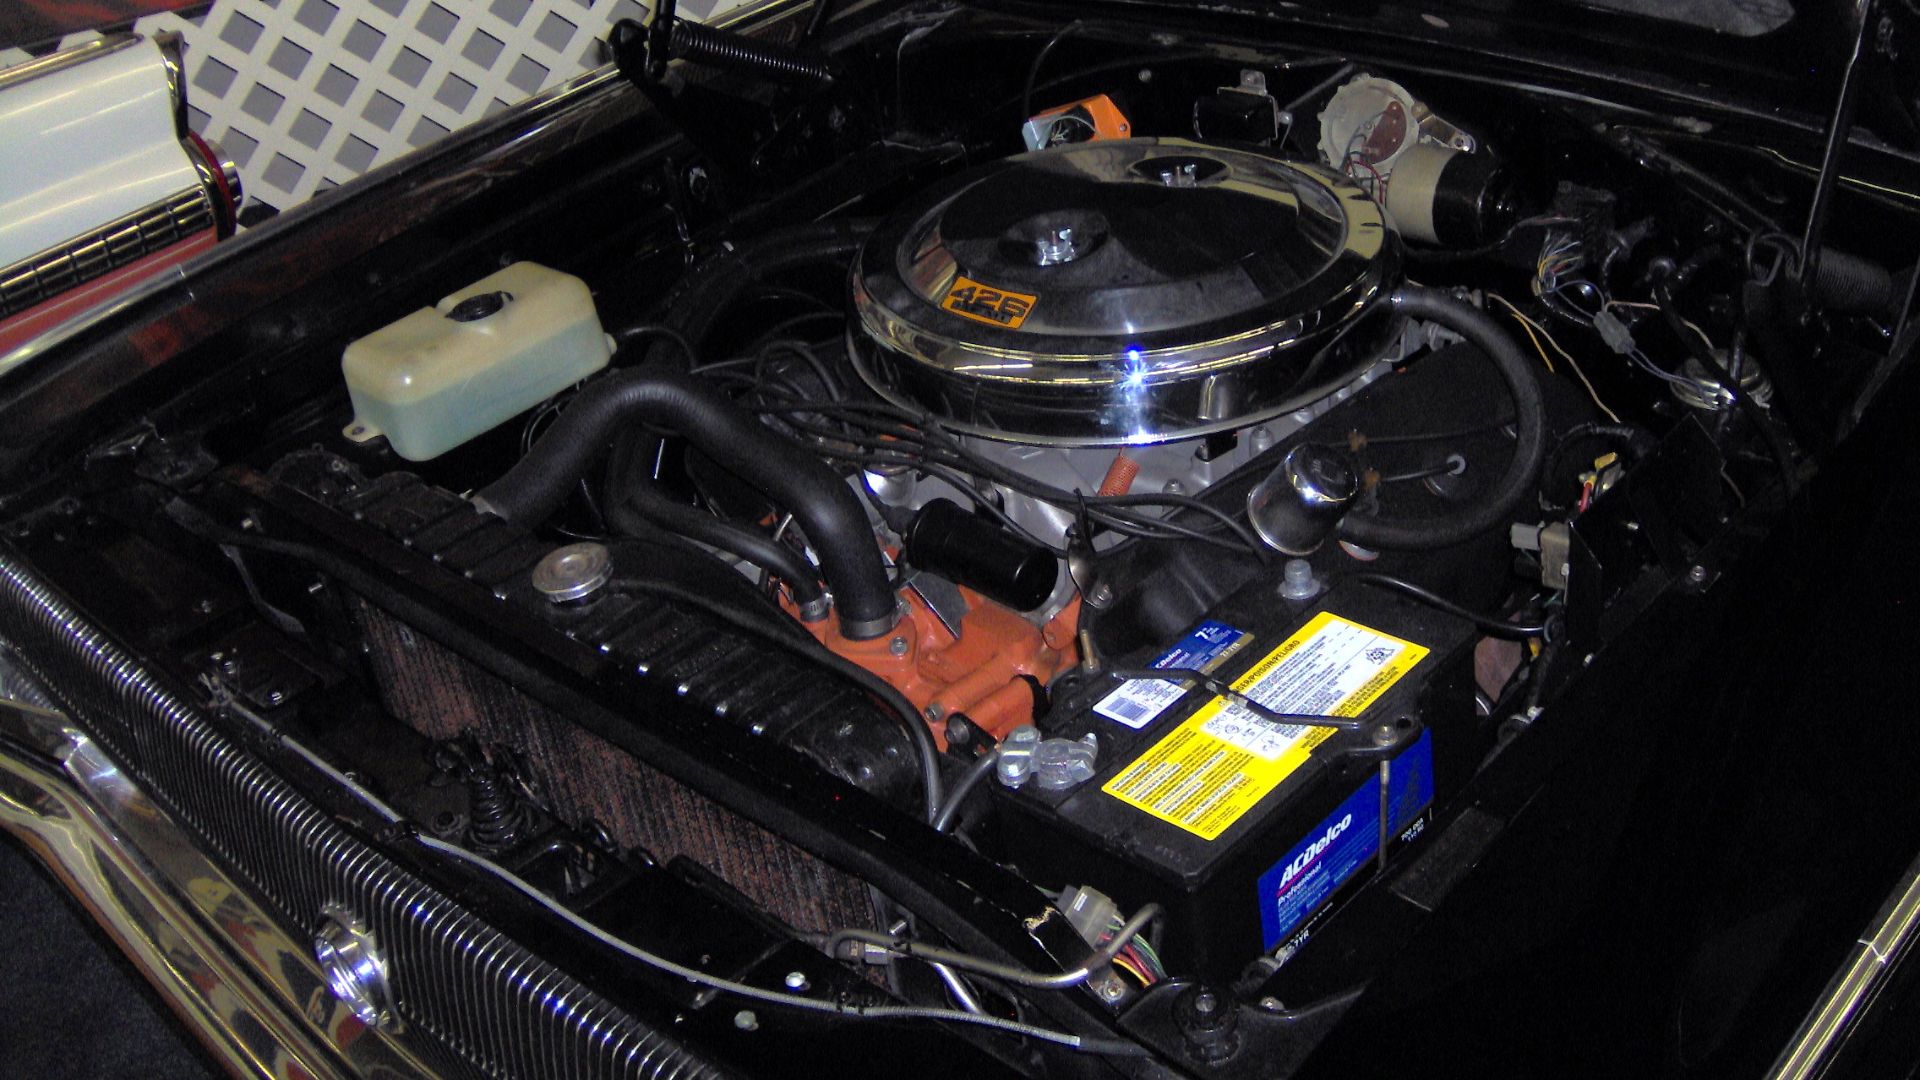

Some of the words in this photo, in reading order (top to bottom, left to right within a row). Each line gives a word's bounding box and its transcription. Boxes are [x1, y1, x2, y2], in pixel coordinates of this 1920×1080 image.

[951, 287, 1030, 317] 426
[1155, 648, 1182, 668] CDelco
[1235, 639, 1300, 692] GER/POISON/PELIGRO
[1279, 813, 1352, 889] ACDelco
